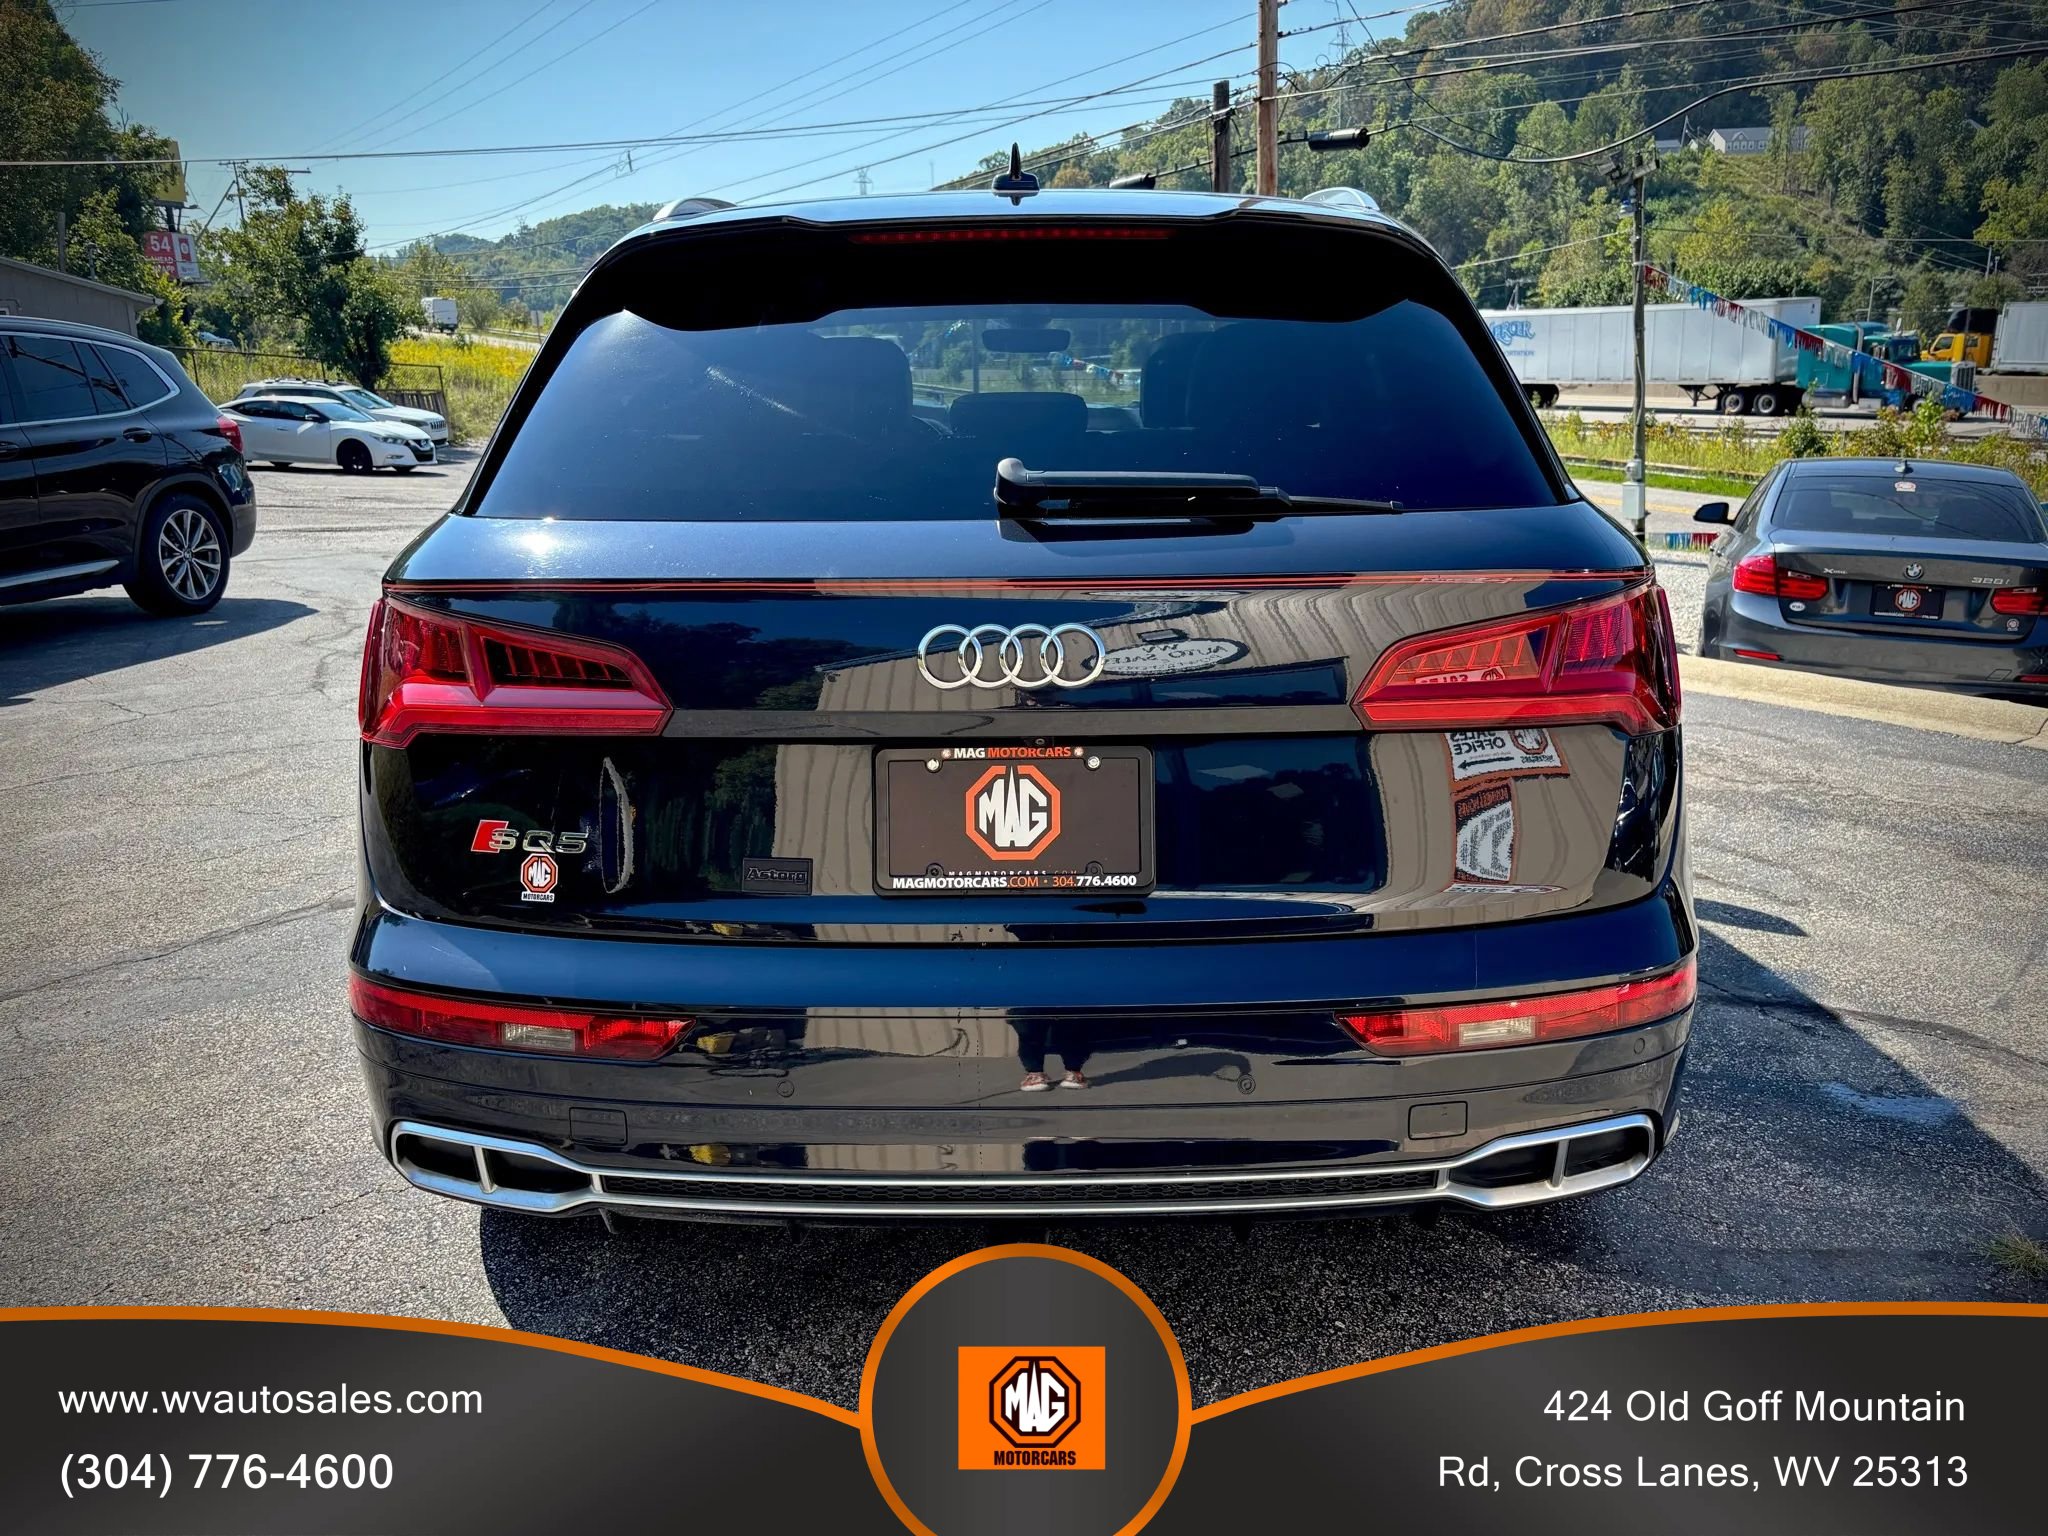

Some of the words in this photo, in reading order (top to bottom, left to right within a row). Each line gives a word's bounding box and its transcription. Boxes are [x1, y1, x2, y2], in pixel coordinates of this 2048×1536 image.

[150, 235, 170, 252] 54
[954, 748, 986, 759] MAG
[987, 746, 1071, 758] MOTORCARS
[979, 765, 1048, 847] MAG
[489, 828, 589, 854] SQ5
[528, 858, 552, 887] MAG
[746, 867, 808, 884] Astorg
[893, 876, 1039, 889] MAGMOTORCARS.COM
[1052, 875, 1137, 888] 304.776.4600
[522, 892, 554, 902] MOTORCARS
